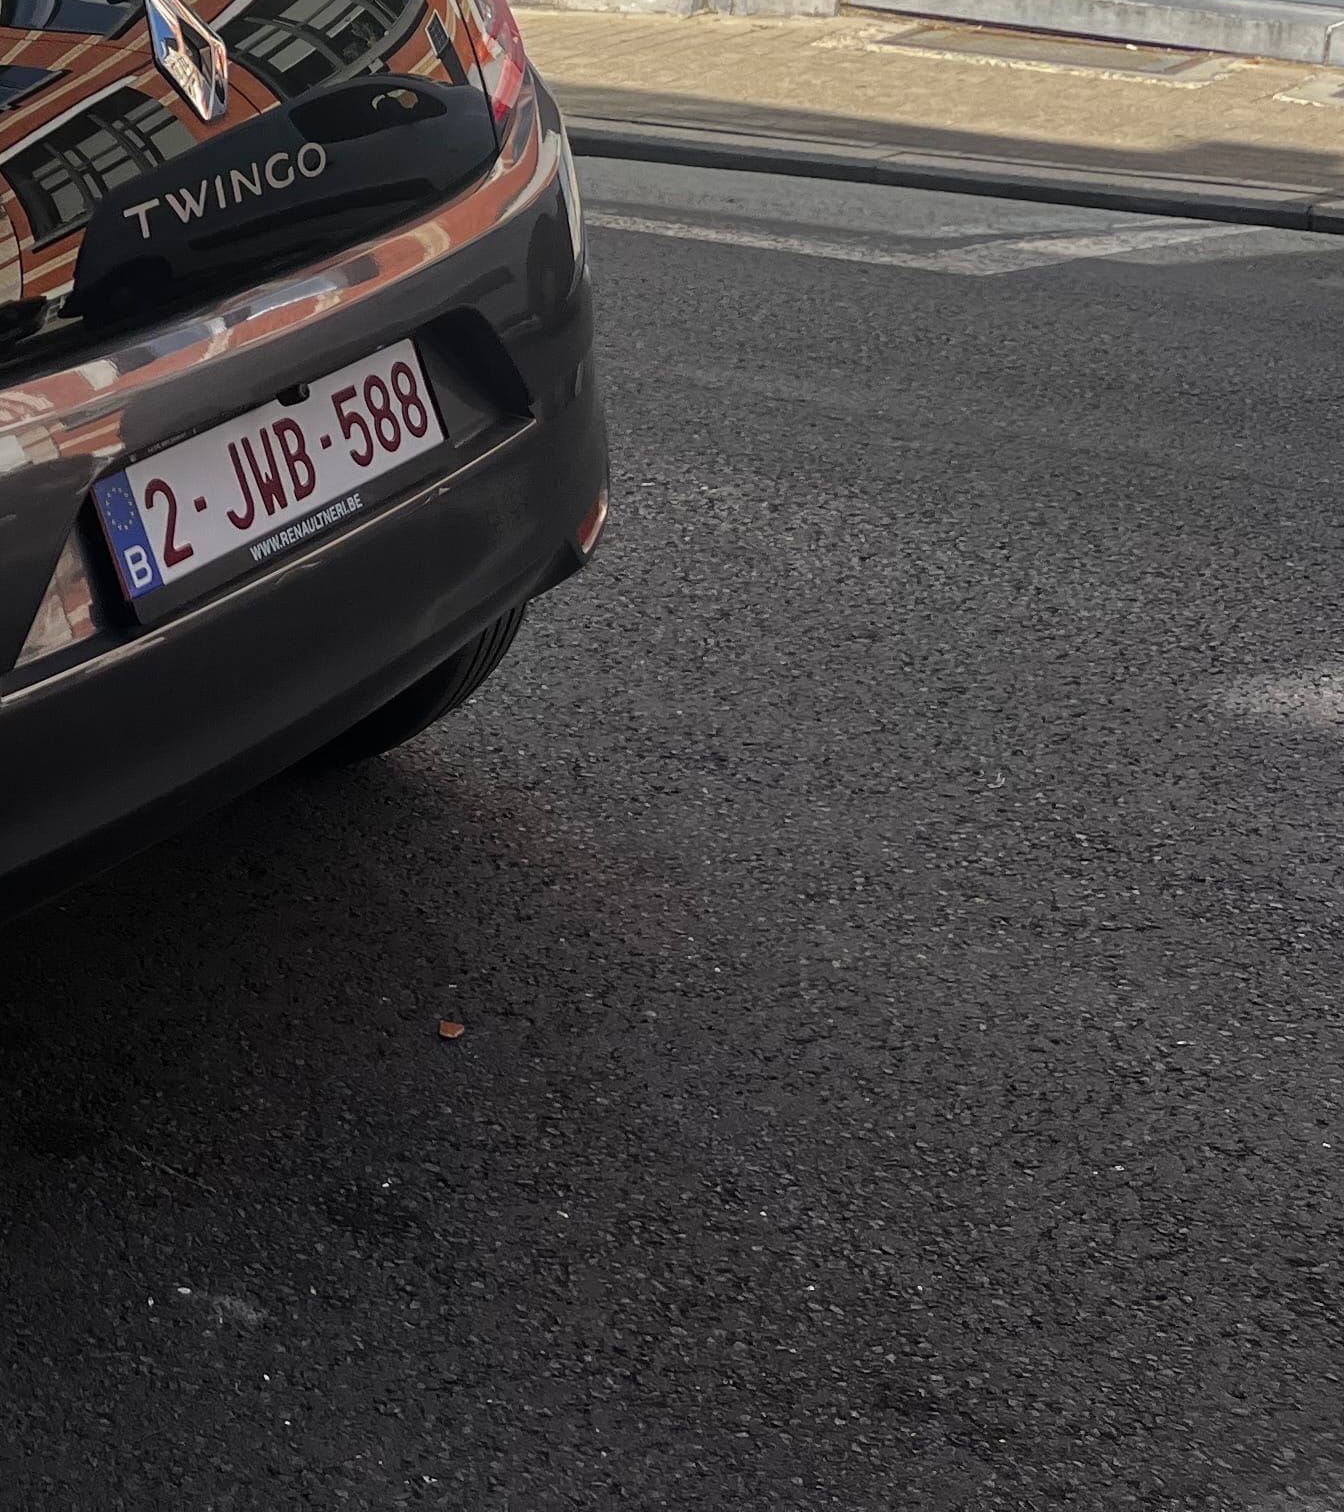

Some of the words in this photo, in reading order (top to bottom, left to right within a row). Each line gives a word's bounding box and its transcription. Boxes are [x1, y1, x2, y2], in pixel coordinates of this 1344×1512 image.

[123, 142, 327, 240] TWINGO
[144, 360, 428, 568] 2-JWB-588
[123, 544, 153, 587] B
[249, 492, 364, 562] WWW.RENAULTNERI.BE
